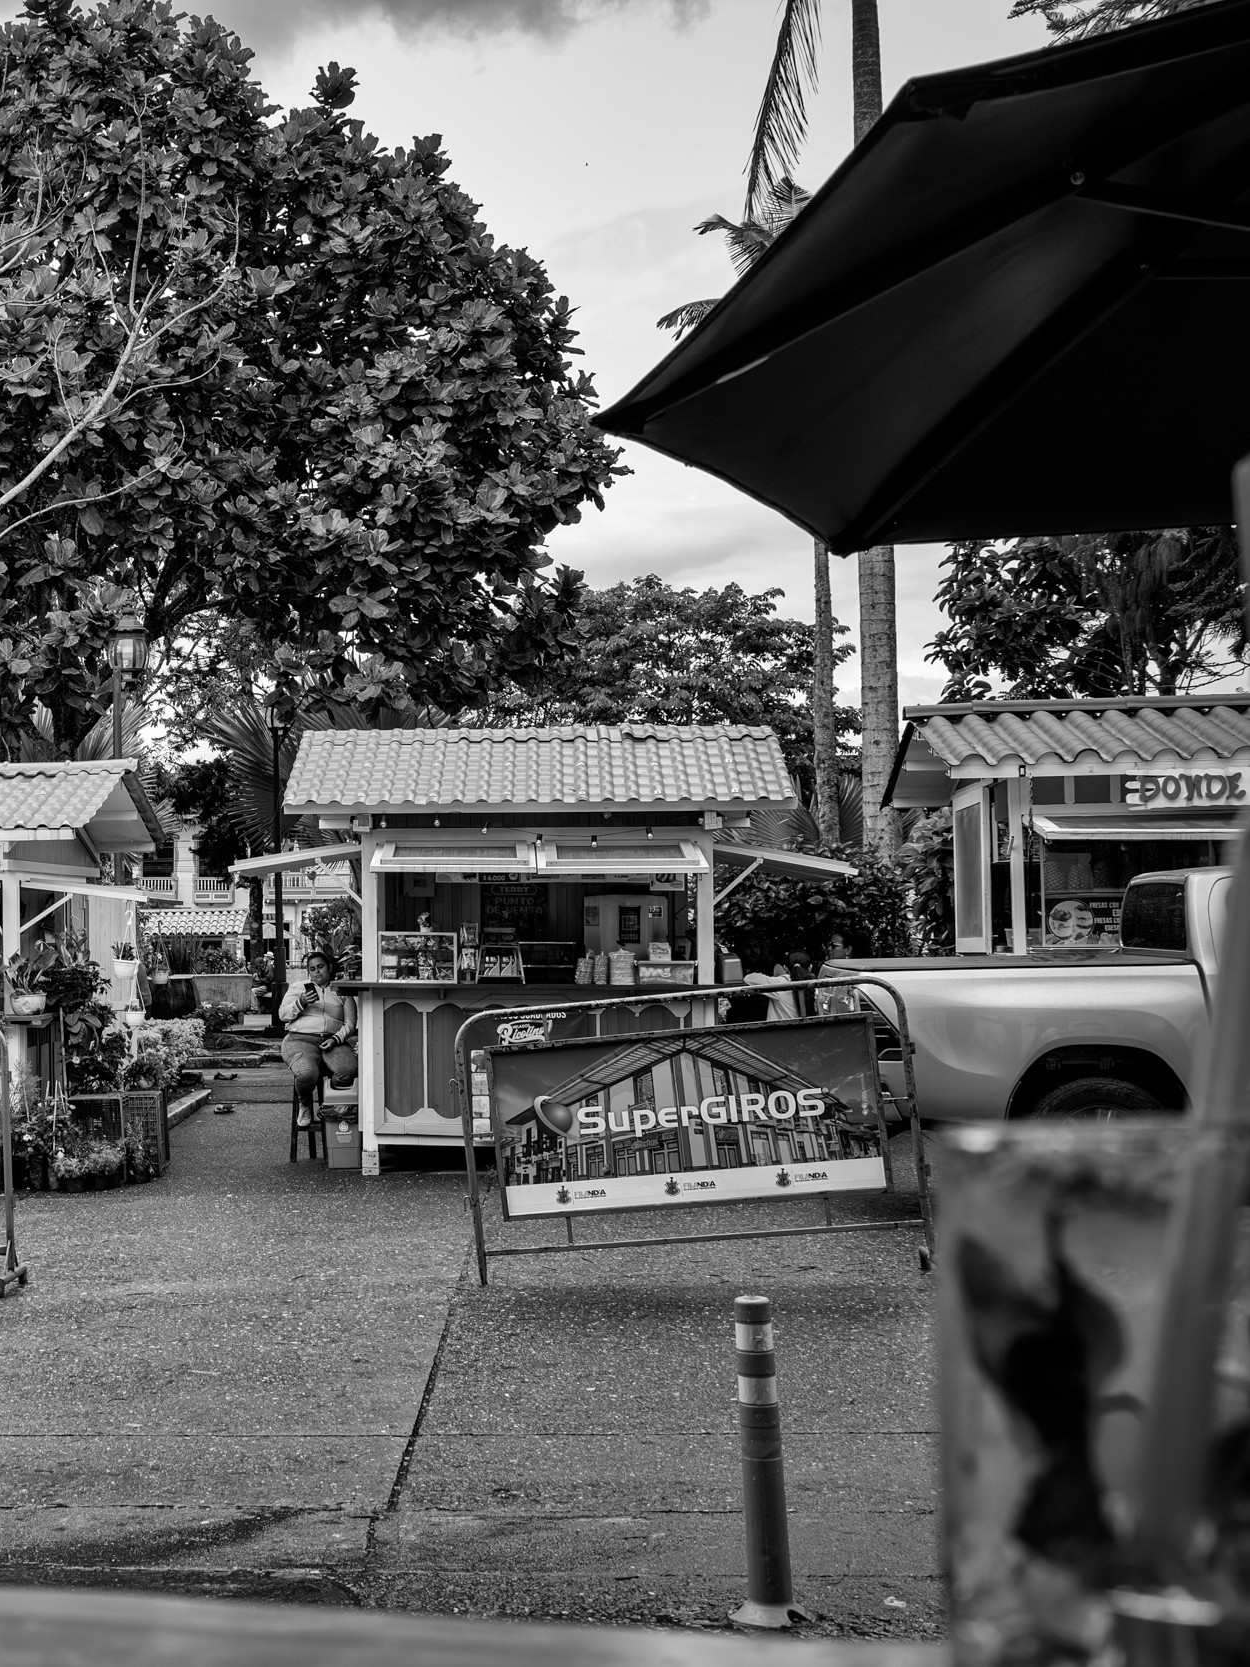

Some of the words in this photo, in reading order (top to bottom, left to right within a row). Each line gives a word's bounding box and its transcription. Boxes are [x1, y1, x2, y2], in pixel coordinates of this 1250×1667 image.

[1136, 772, 1246, 803] DONDE
[486, 905, 500, 914] DE
[505, 905, 543, 914] VENTA
[495, 897, 535, 905] PUNTO
[577, 1088, 825, 1137] SuperGIROS
